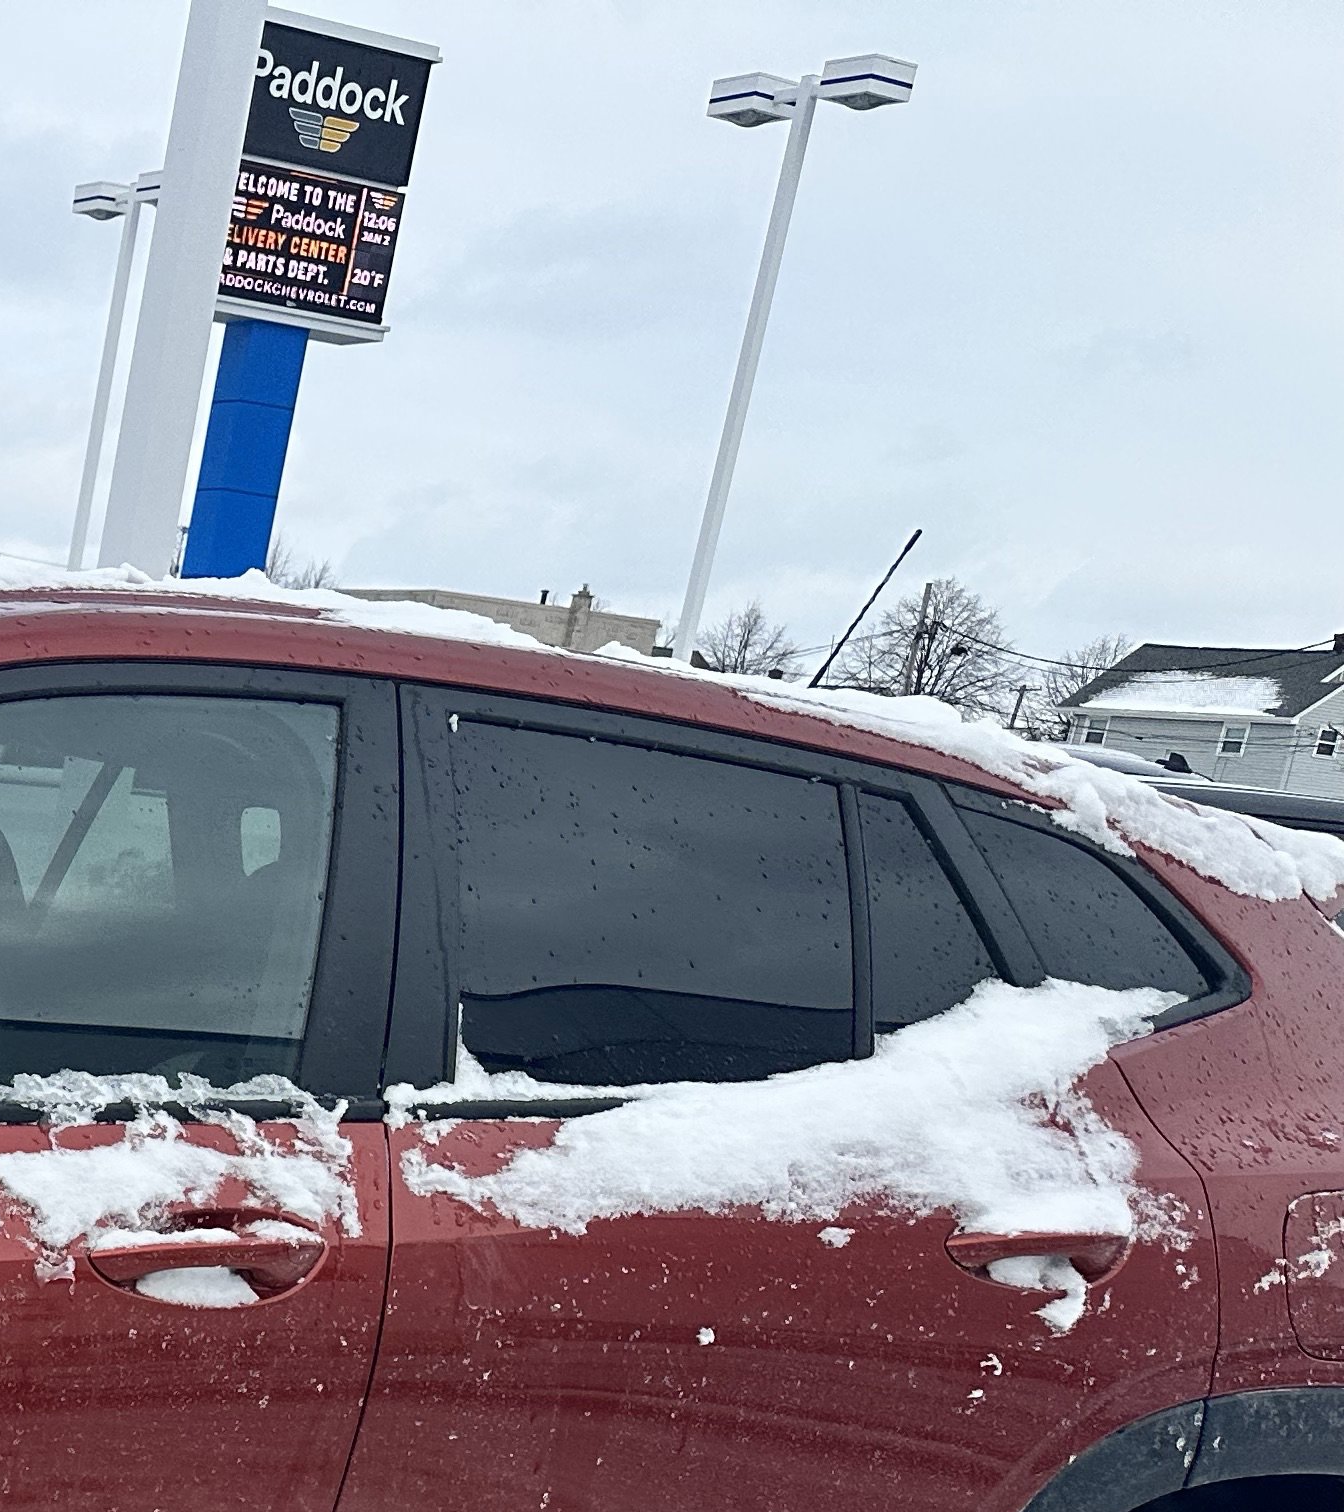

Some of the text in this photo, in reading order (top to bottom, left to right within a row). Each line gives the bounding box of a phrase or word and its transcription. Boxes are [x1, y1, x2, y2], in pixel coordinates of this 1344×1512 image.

[255, 48, 410, 125] Paddock
[238, 171, 357, 214] ELCOME TO THE
[270, 203, 346, 239] Paddock
[360, 231, 382, 245] JAN
[362, 210, 396, 232] 12:06
[226, 224, 348, 265] ELIVERY CENTER
[235, 249, 286, 276] PARTS
[287, 259, 330, 285] DEPT.
[219, 272, 376, 314] ADDOCKCHEVROLET.COM
